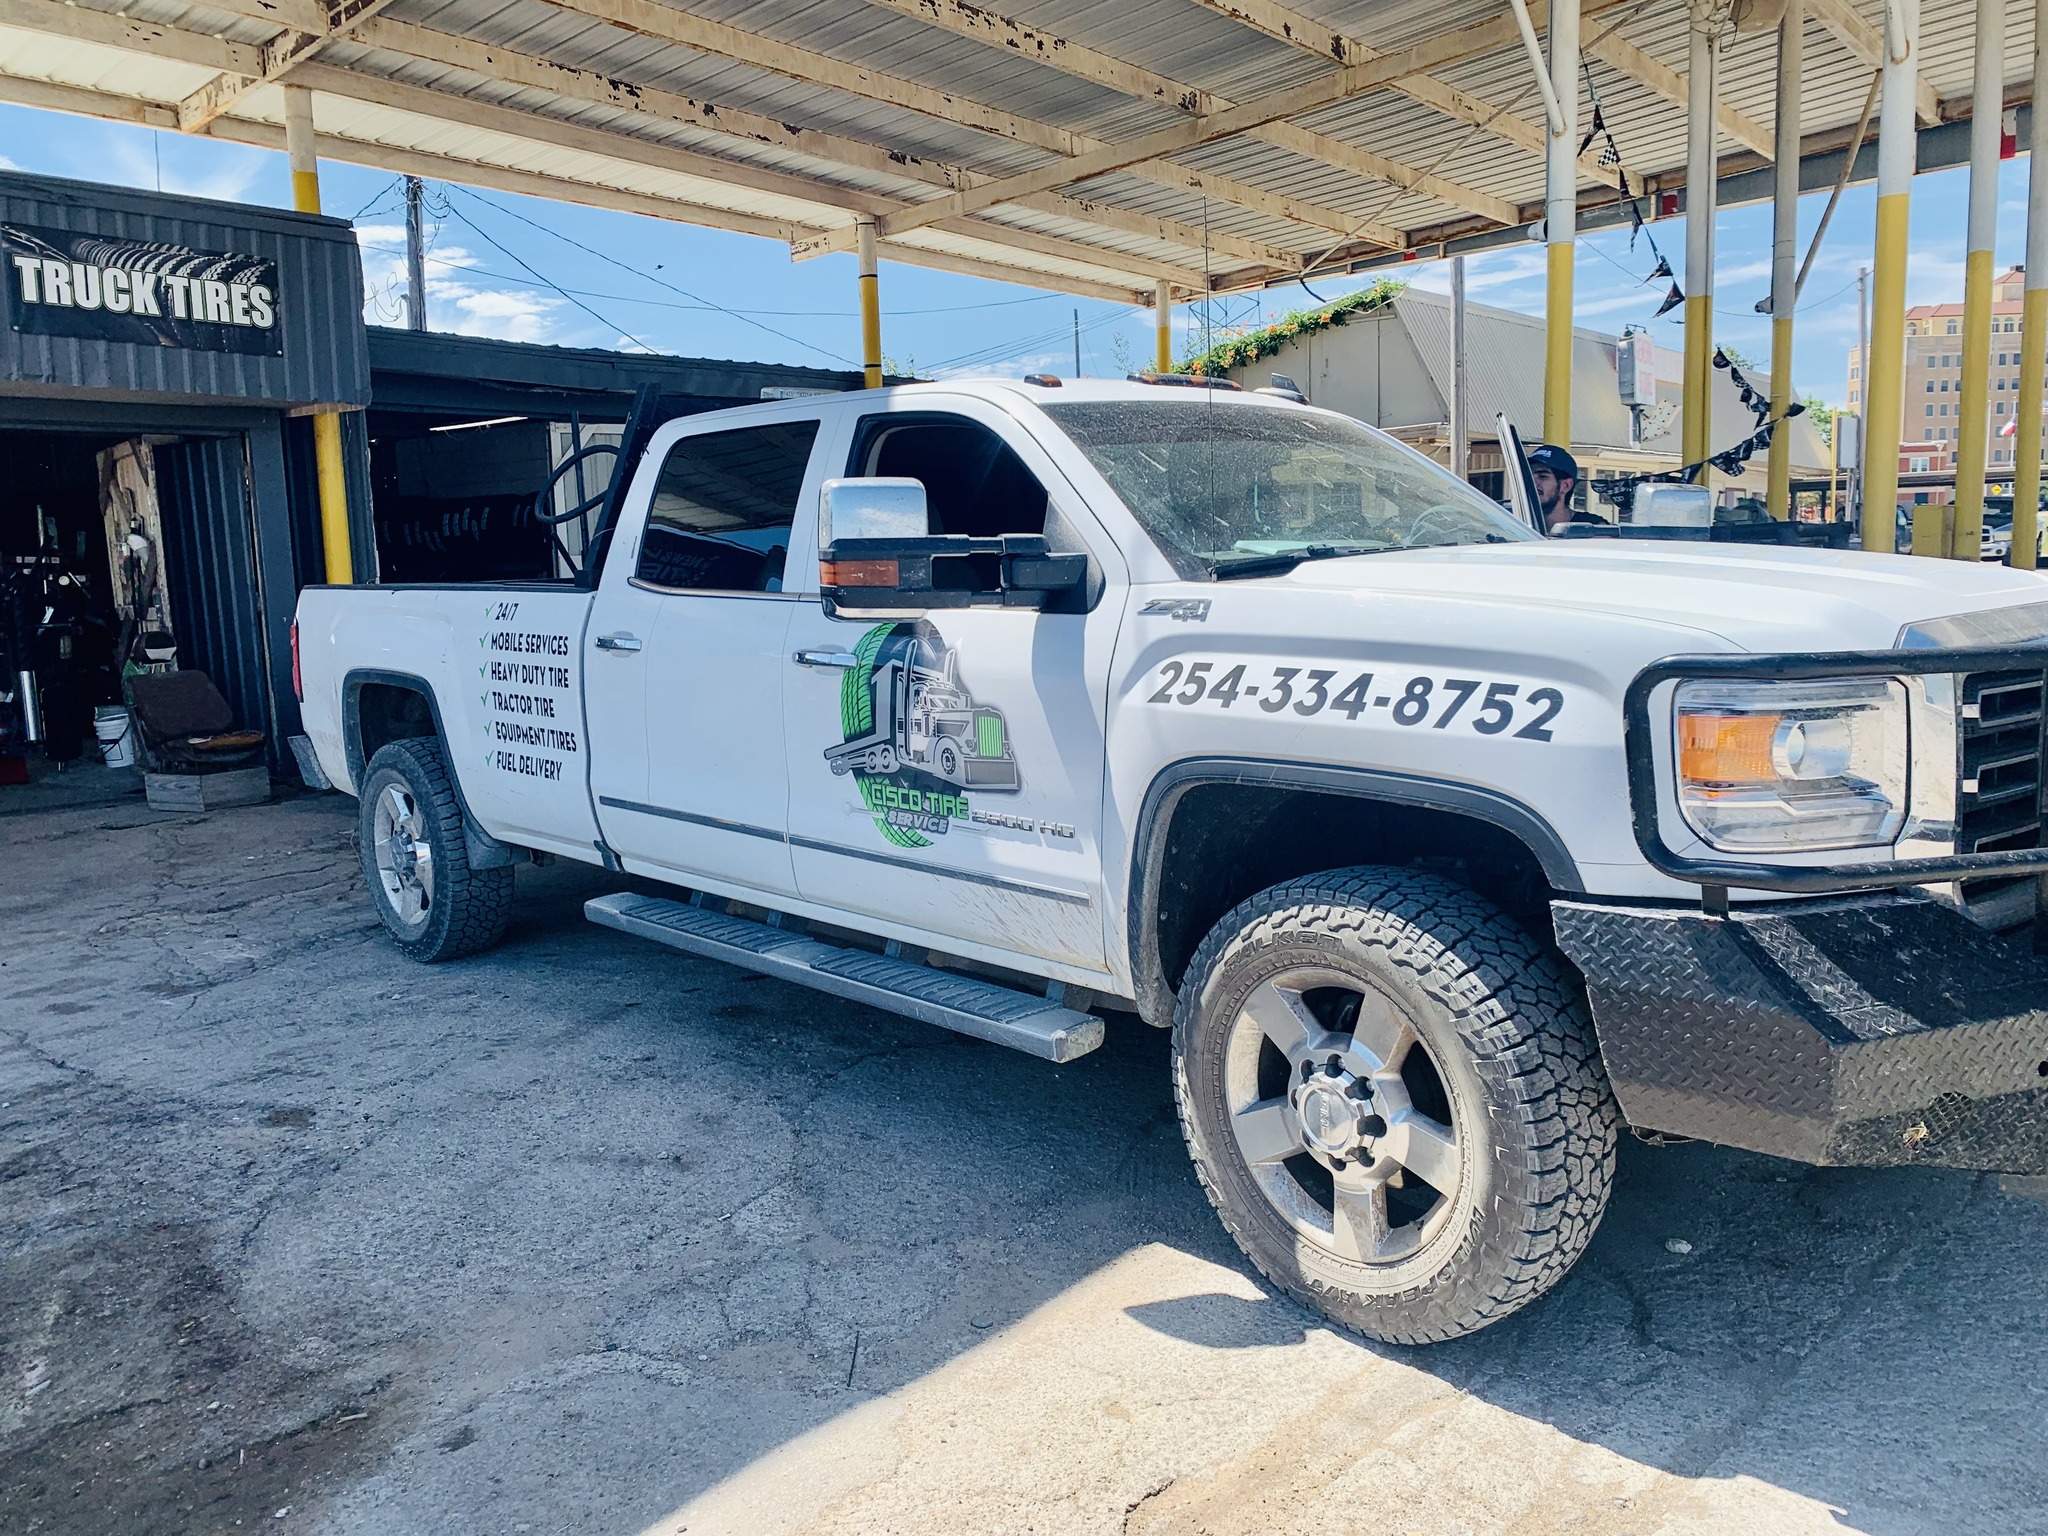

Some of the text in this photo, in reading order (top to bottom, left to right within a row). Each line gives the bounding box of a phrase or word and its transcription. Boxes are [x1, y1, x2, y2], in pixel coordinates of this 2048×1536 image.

[13, 255, 275, 329] TRUCK TIRES
[495, 603, 519, 621] 24/7
[491, 632, 568, 656] MOBILE SERVICES
[491, 661, 569, 688] HEAVY DUTY TIRE
[492, 691, 555, 718] TRACTOR TIRE
[1147, 661, 1565, 743] 254-334-8752
[495, 721, 577, 752] EQUIPMENT/TIRES
[497, 751, 562, 781] FUEL DELIVERY
[871, 784, 970, 821] CISCO TIRE
[887, 809, 949, 834] SERVICE
